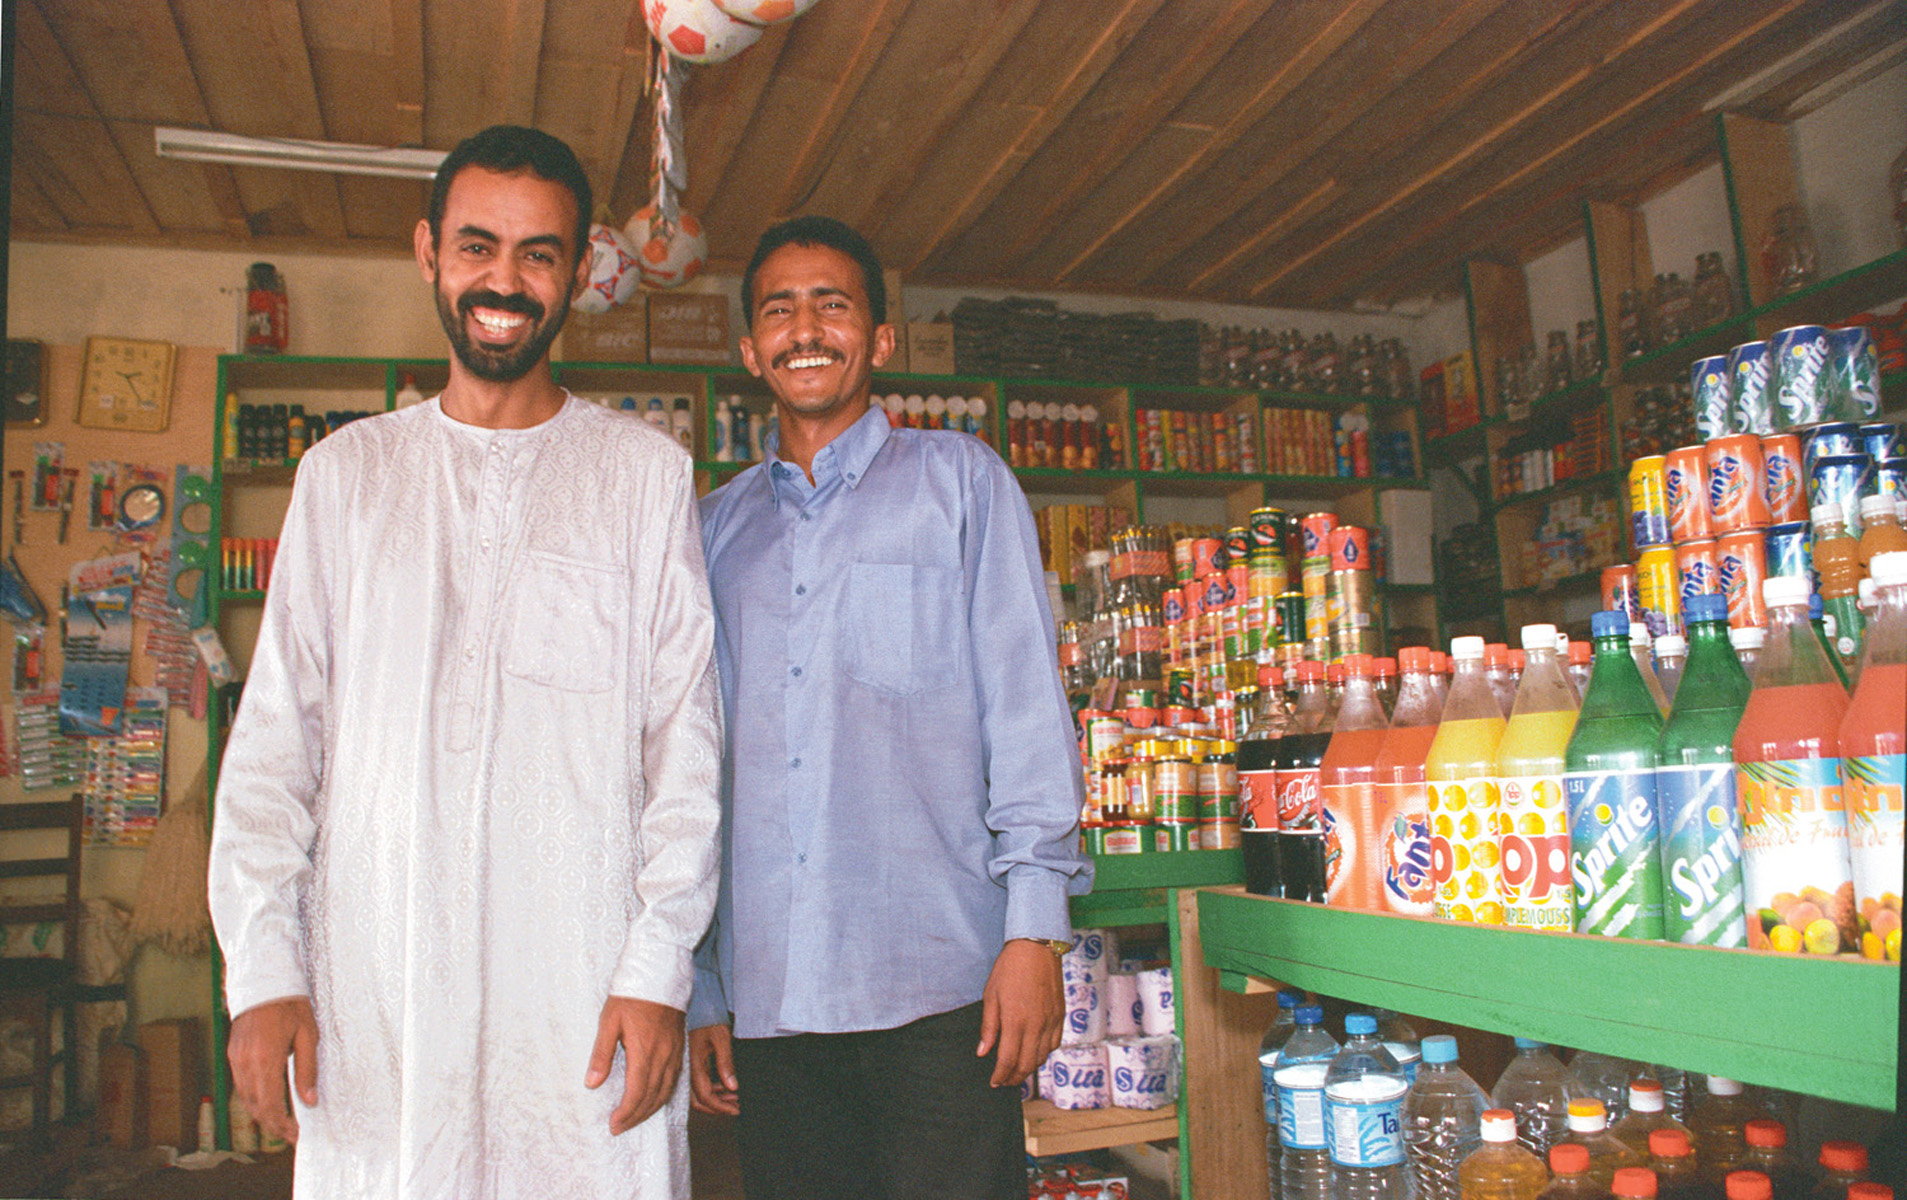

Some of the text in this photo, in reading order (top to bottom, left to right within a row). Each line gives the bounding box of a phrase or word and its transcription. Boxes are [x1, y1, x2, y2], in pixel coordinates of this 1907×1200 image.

[1779, 335, 1829, 421] Sprite
[1711, 456, 1740, 515] anta
[1385, 820, 1431, 901] Fant
[1571, 796, 1653, 909] Sprite
[1671, 808, 1742, 920] Spri
